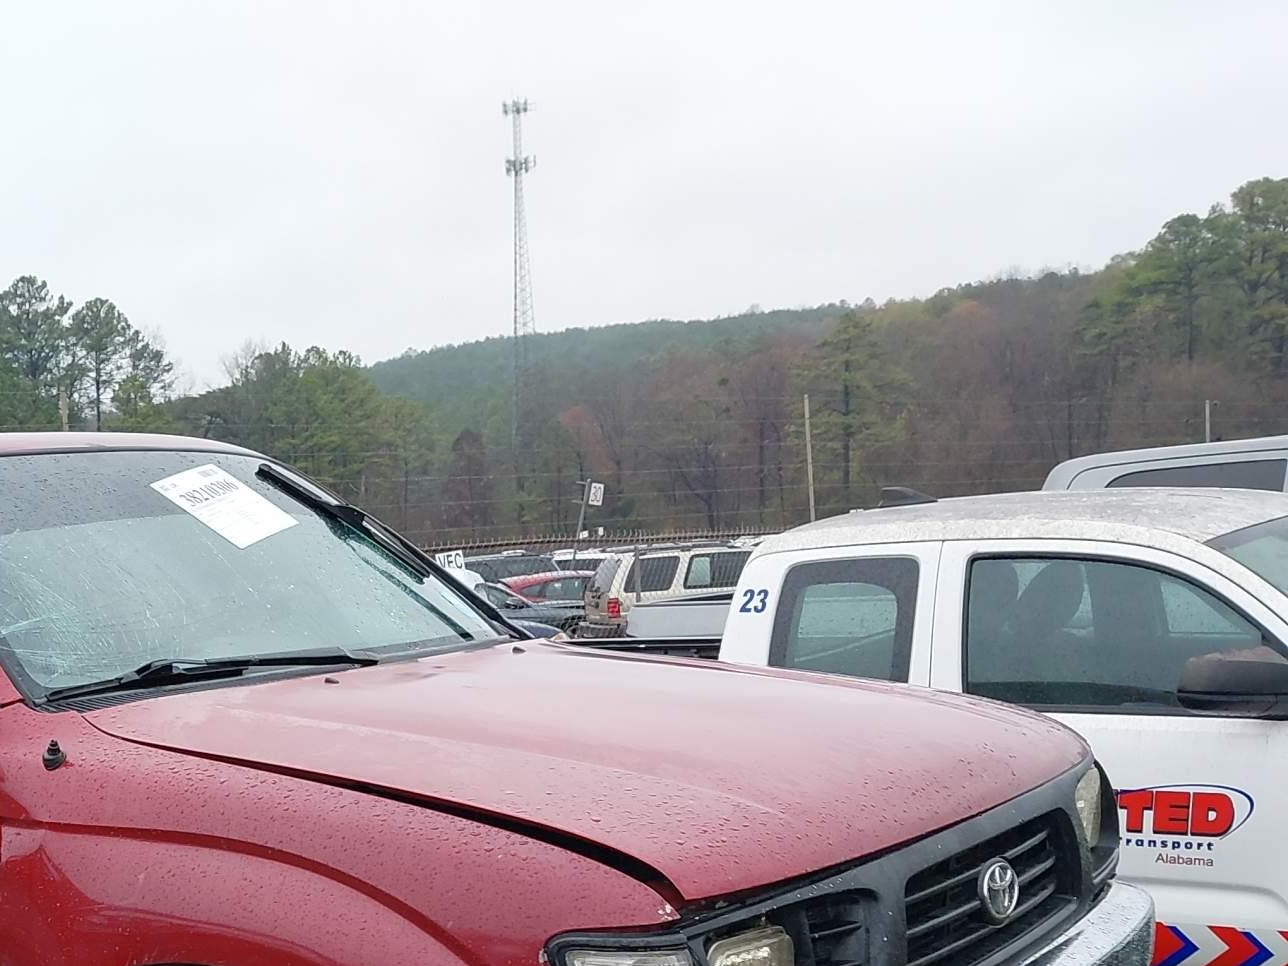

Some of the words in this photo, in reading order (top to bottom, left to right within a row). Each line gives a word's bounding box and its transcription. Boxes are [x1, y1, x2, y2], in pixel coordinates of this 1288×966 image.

[179, 479, 239, 507] 38210306
[739, 589, 769, 613] 23
[1112, 789, 1235, 837] TED
[1119, 837, 1215, 851] ransport
[1155, 852, 1214, 867] Alabama
